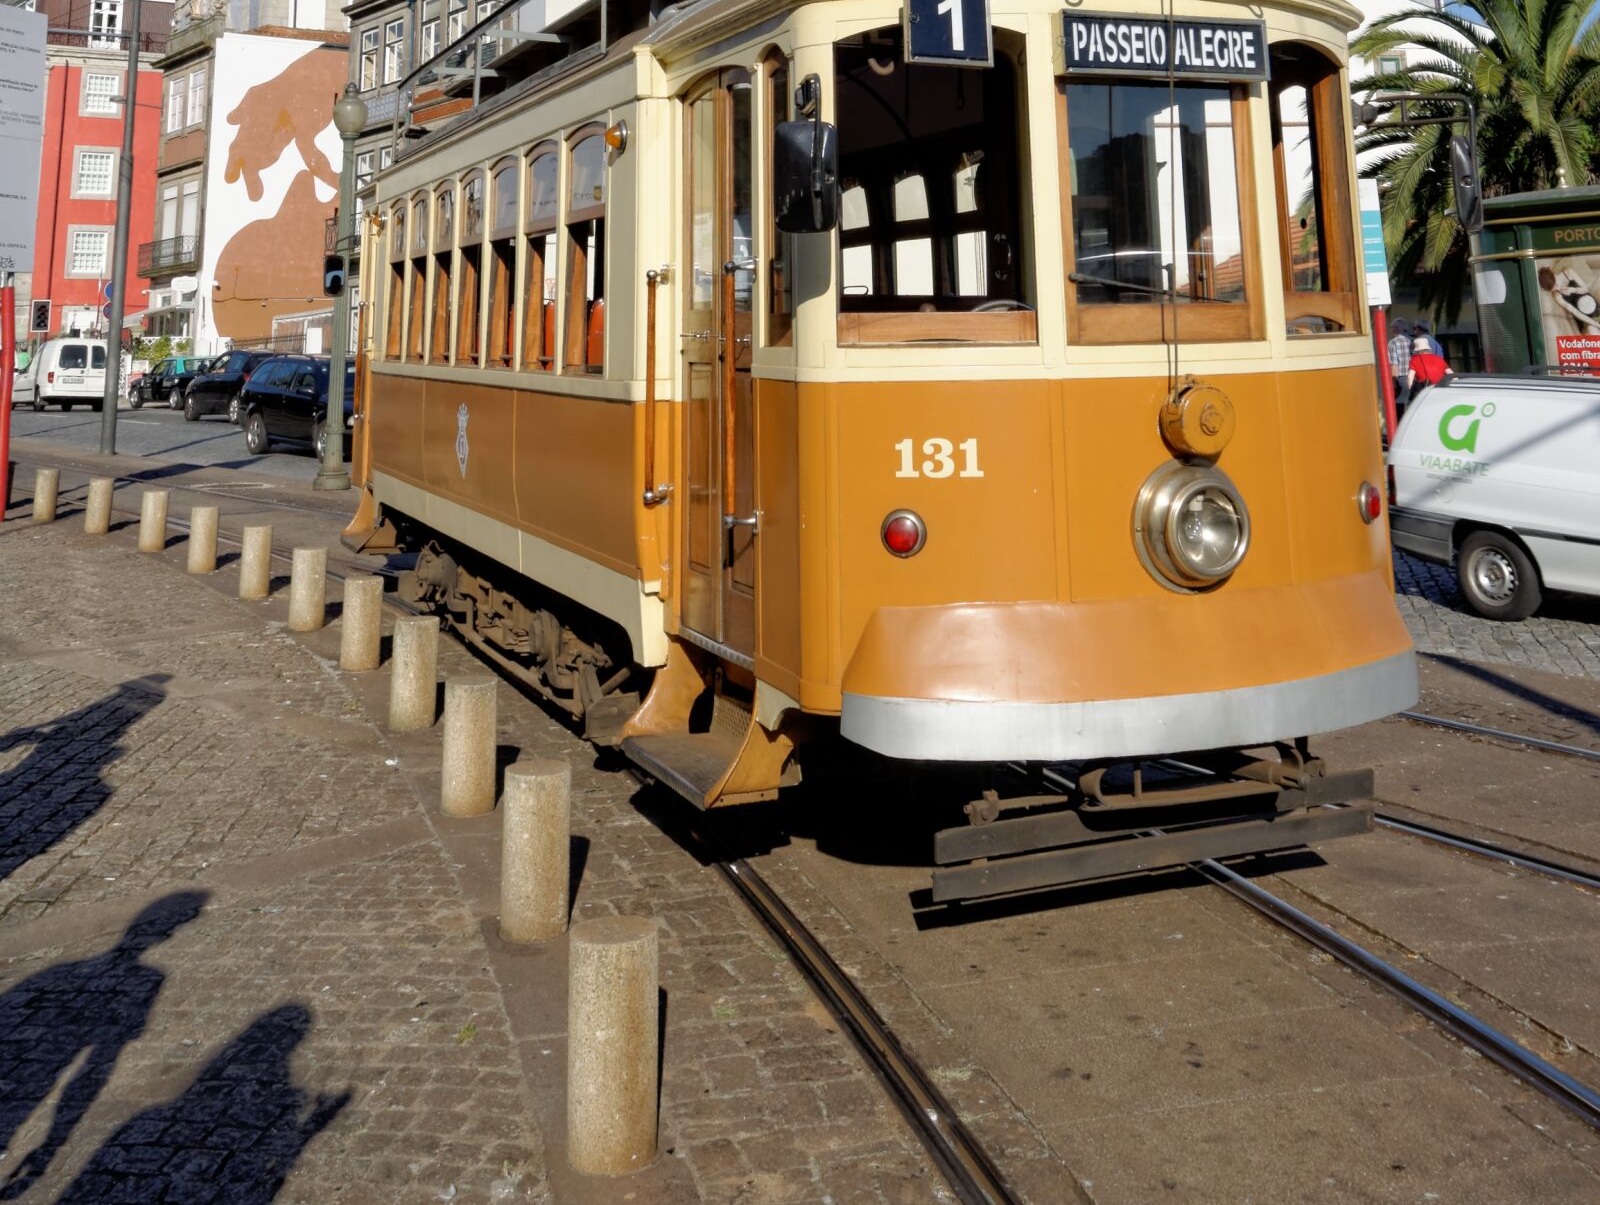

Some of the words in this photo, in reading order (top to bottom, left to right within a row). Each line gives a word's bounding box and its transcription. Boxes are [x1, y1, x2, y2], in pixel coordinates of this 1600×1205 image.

[1071, 22, 1166, 65] PASSEIO
[1174, 28, 1256, 68] ALEGRE
[1560, 352, 1581, 361] com
[895, 437, 984, 479] 131
[1419, 454, 1490, 476] VIAABATE
